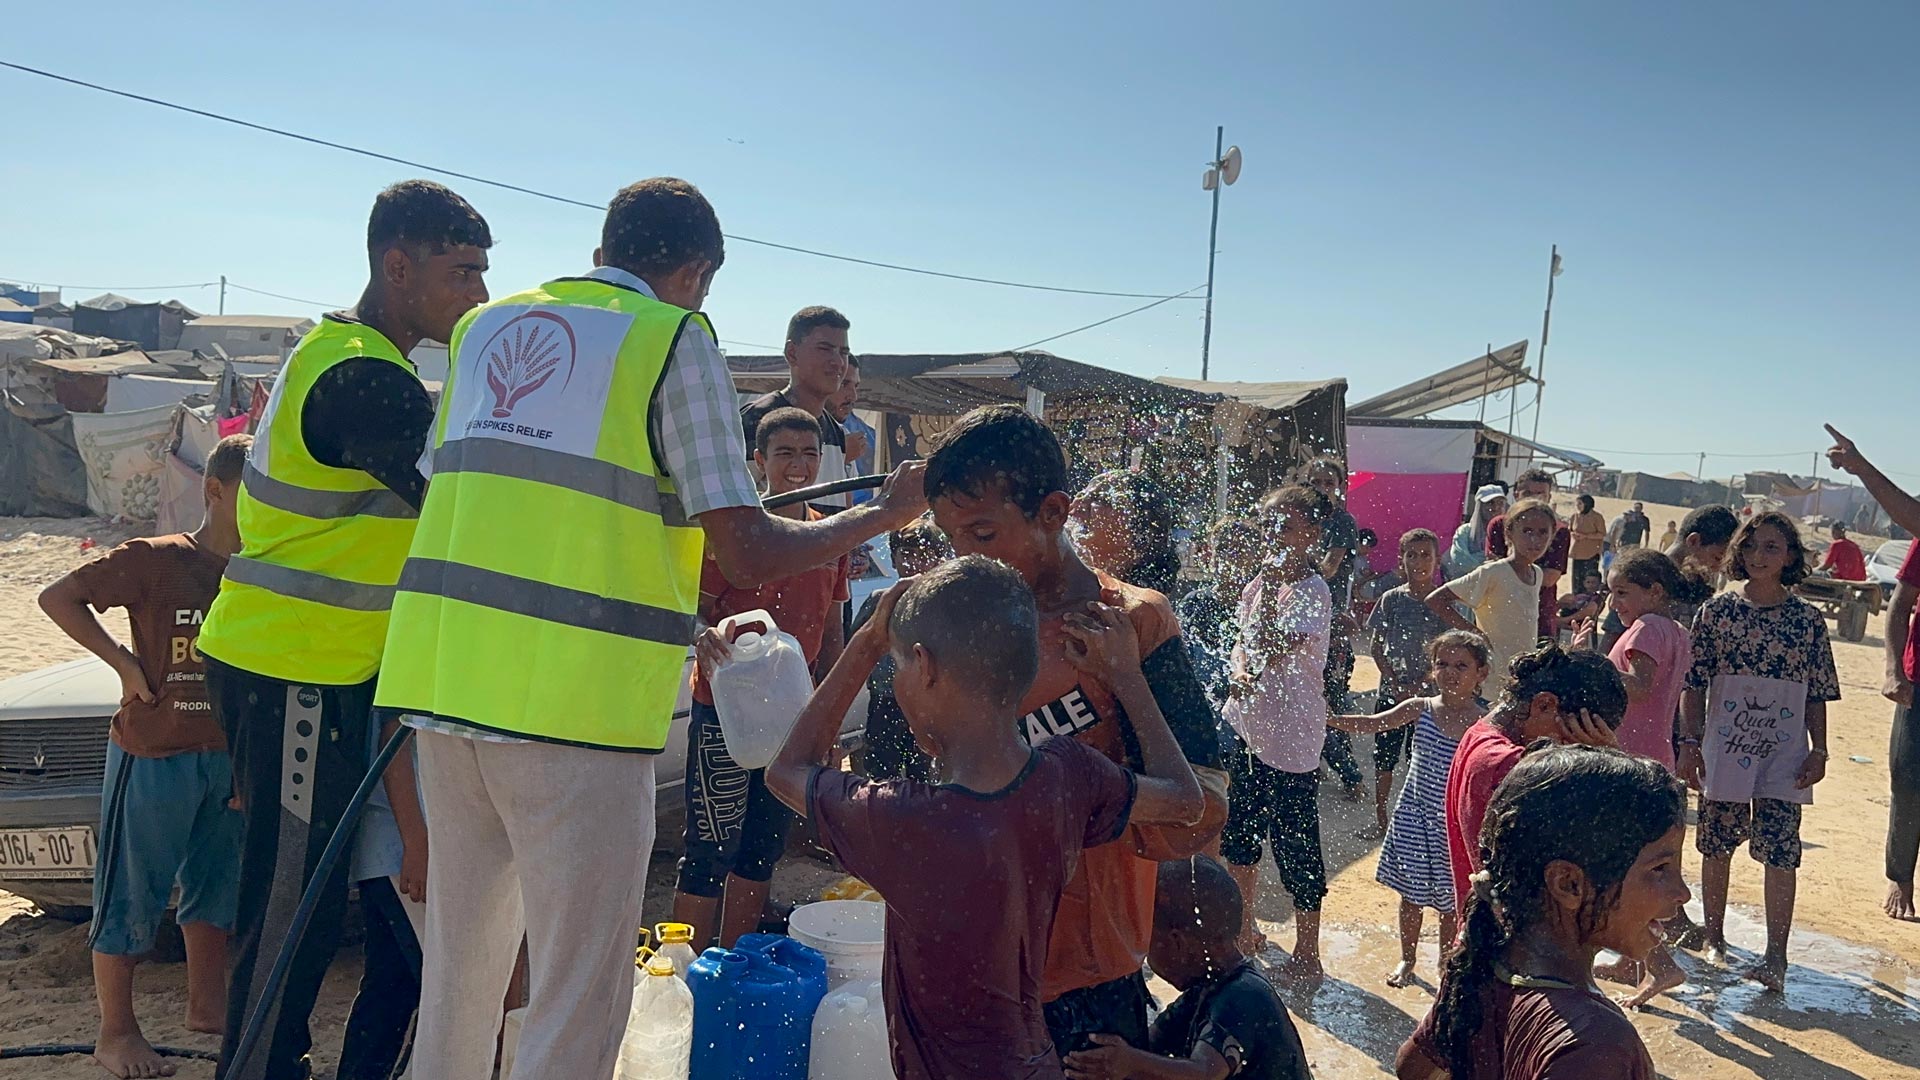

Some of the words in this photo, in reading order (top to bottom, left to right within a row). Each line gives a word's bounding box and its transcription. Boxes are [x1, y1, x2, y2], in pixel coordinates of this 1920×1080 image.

[483, 420, 515, 433] SPIKES
[516, 425, 553, 440] RELIEF
[1017, 690, 1095, 748] ALE
